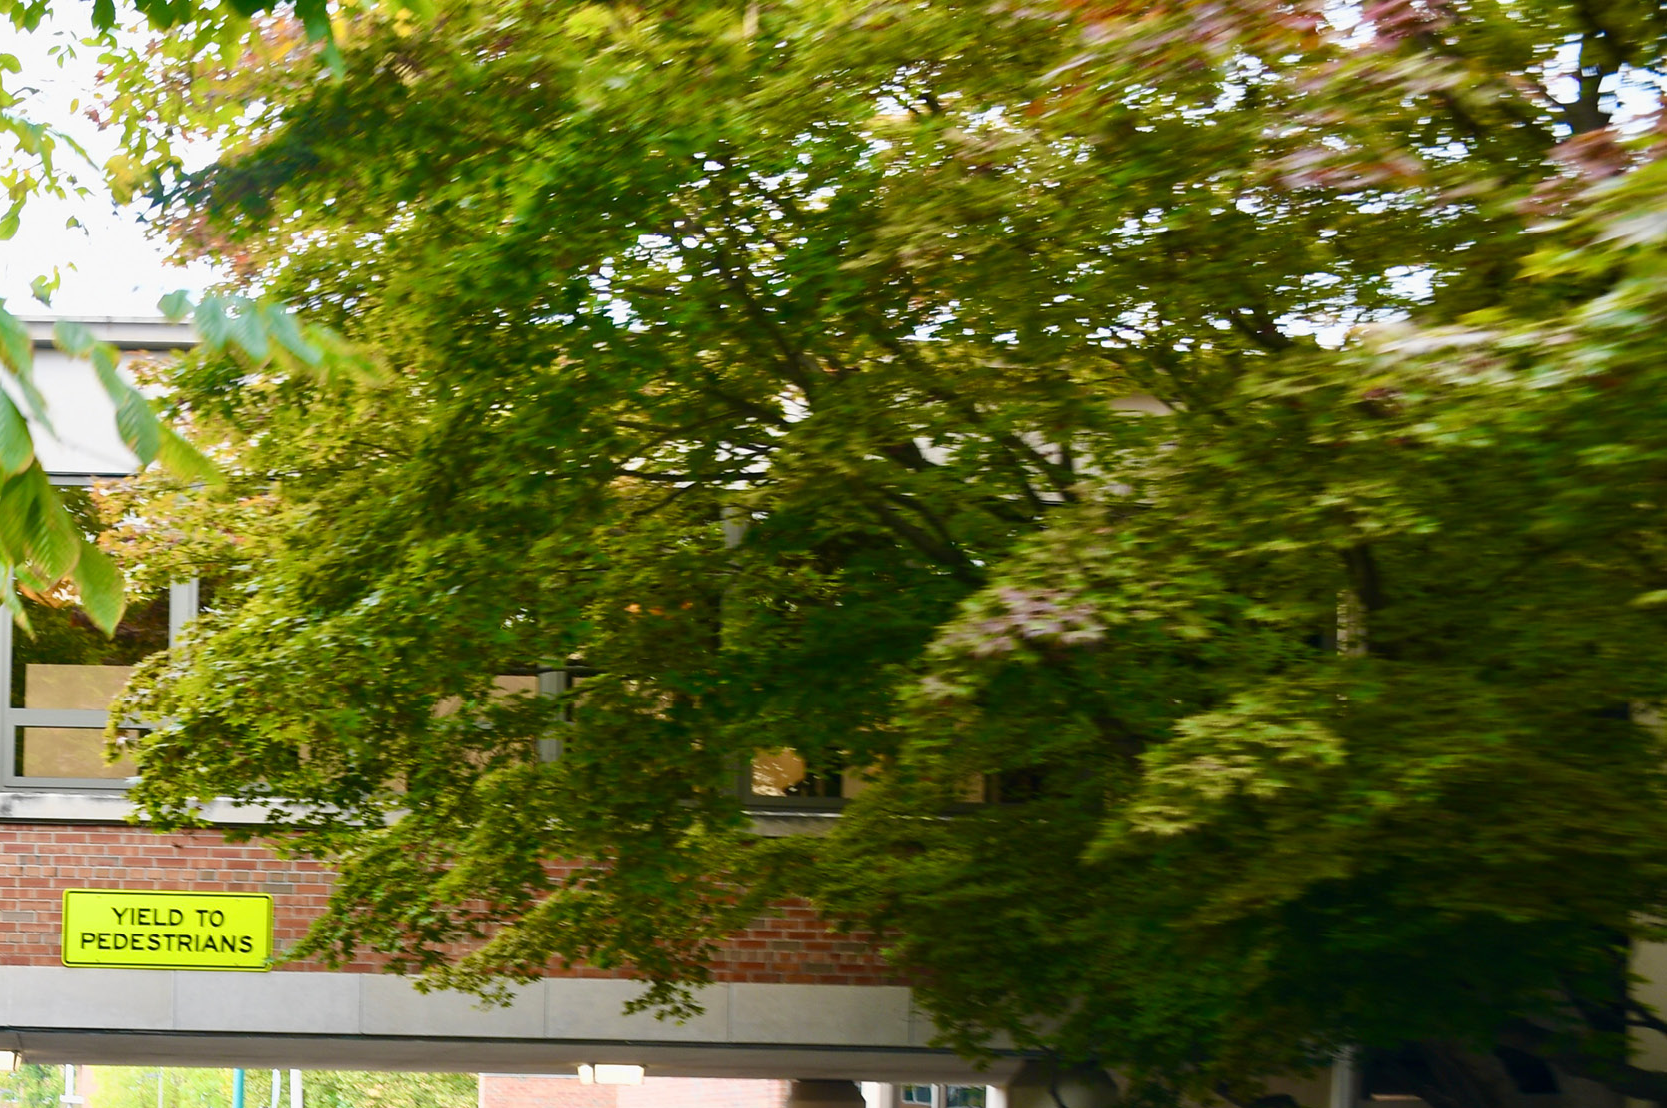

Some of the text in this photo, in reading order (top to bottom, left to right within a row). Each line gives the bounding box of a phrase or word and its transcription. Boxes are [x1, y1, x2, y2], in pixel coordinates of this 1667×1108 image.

[112, 907, 224, 927] YIELD TO
[80, 932, 253, 953] PEDESTRIANS
